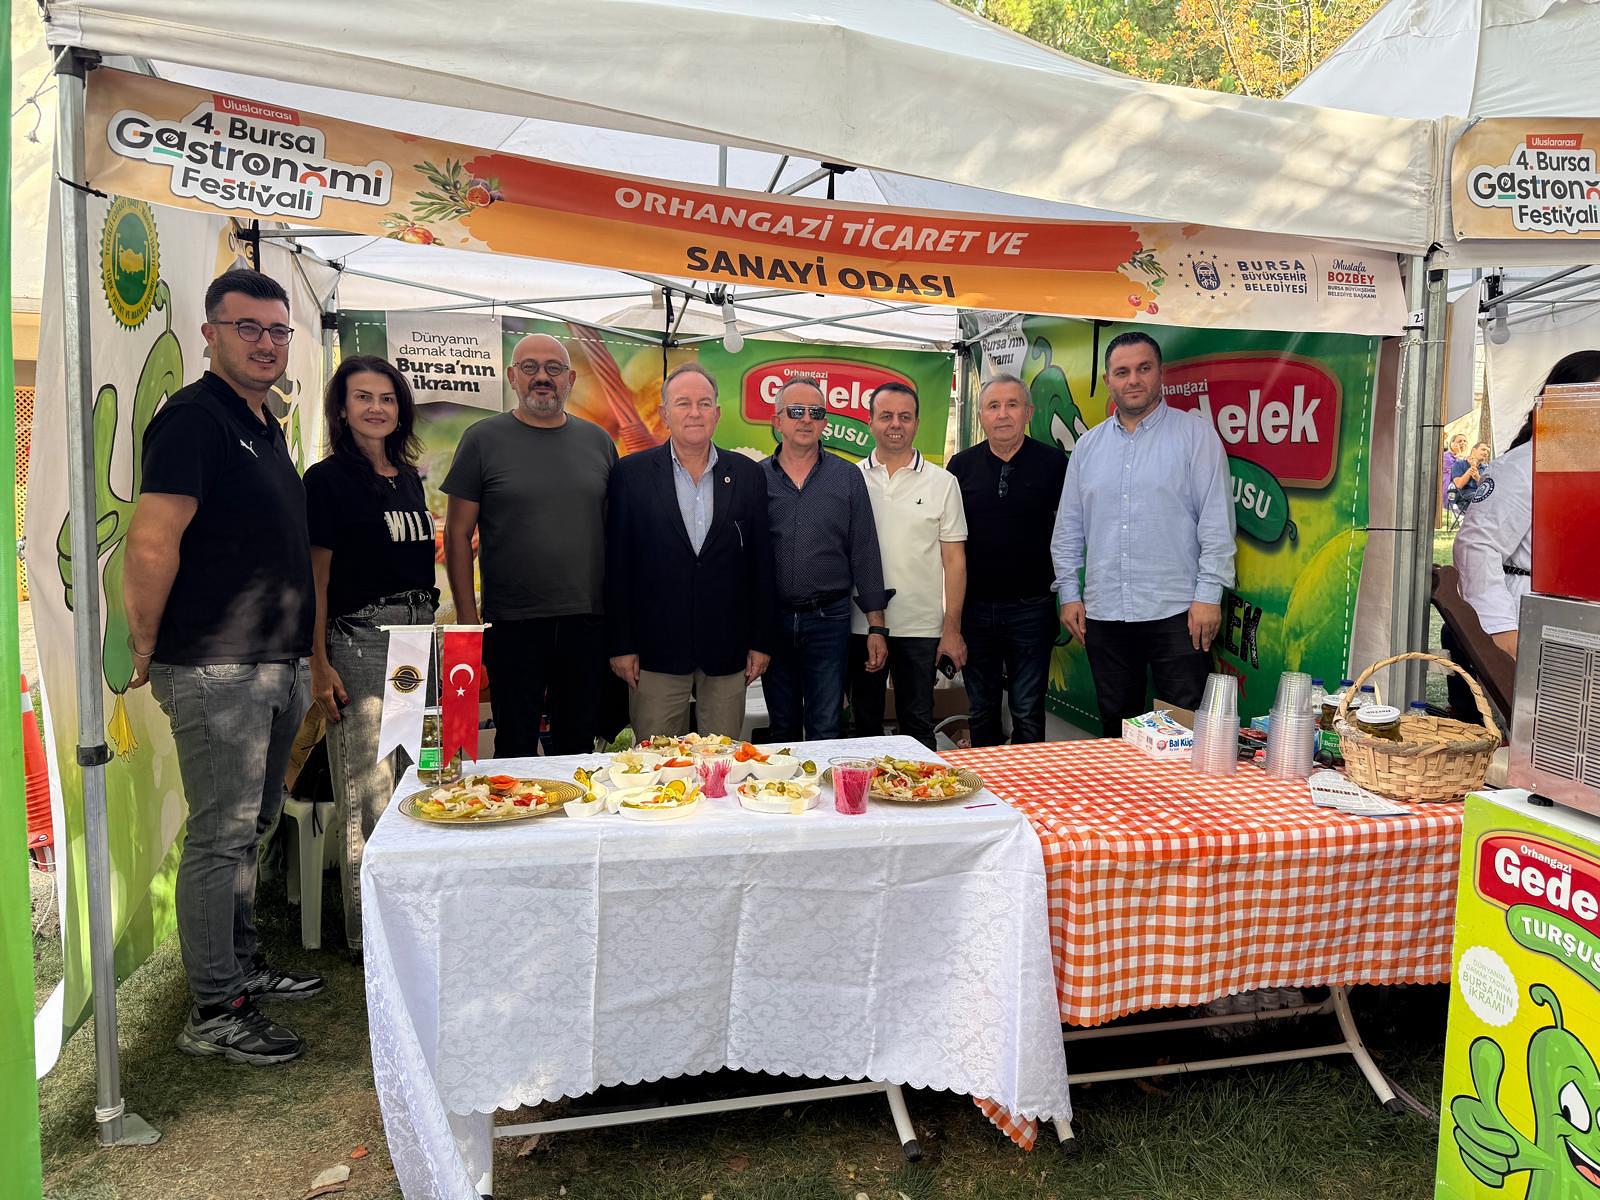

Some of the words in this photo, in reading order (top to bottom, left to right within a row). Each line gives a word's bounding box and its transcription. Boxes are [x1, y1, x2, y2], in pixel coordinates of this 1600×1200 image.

[222, 98, 293, 121] Uluslararası
[191, 111, 221, 136] 4.
[228, 117, 316, 154] Bursa
[1531, 137, 1577, 147] Uluslararası
[1516, 151, 1534, 170] 4.
[1536, 151, 1590, 171] Bursa
[182, 168, 313, 212] Festivali
[614, 187, 833, 240] ORHANGAZİ
[842, 217, 981, 254] TİCARET
[985, 231, 1028, 256] VE
[1519, 204, 1598, 227] Festivali
[686, 246, 827, 287] SANAYİ
[838, 268, 956, 298] ODASI
[1237, 259, 1305, 271] BURSA
[1332, 259, 1367, 273] Mustafa
[1242, 271, 1307, 282] BÜYÜKŞEHİR
[1327, 271, 1375, 285] BOZBEY
[1245, 282, 1308, 294] BELEDİYESİ
[412, 331, 479, 346] Dünyanın
[400, 344, 446, 357] damak
[450, 347, 491, 359] tadına
[395, 358, 496, 377] Bursa'nın
[412, 375, 480, 392] ikramı
[1161, 379, 1208, 397] hangazi
[822, 423, 869, 446] ŞUSU
[1232, 476, 1271, 519] USU
[1169, 739, 1179, 748] Bal
[1181, 738, 1194, 748] Küp
[1520, 844, 1573, 874] Orhangazi
